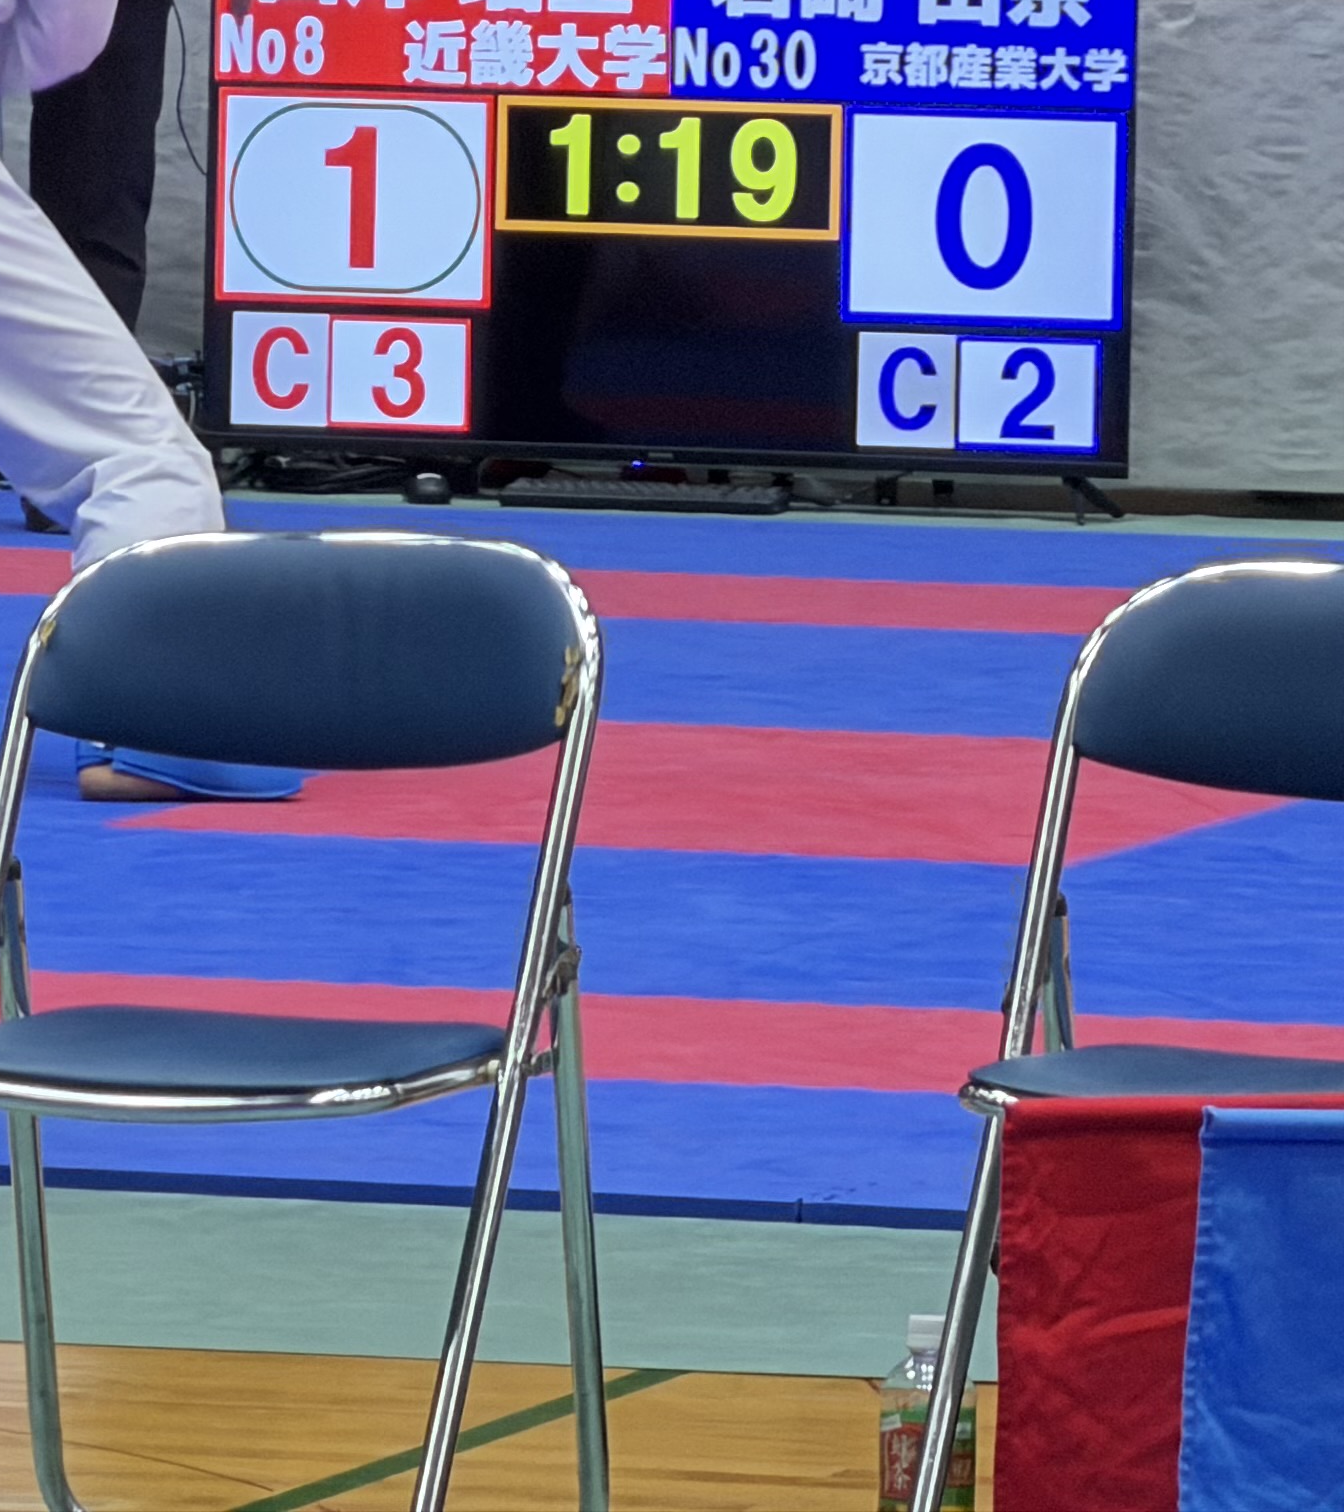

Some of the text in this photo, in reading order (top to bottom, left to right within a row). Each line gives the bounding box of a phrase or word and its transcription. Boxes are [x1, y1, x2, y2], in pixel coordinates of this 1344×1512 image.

[219, 13, 667, 89] No8 近畿大学
[673, 27, 1128, 92] No30 京都産業大学
[324, 124, 379, 270] 1
[549, 114, 798, 222] 1:19
[934, 142, 1033, 291] 0
[251, 326, 426, 419] C 3
[877, 346, 1056, 442] C 2
